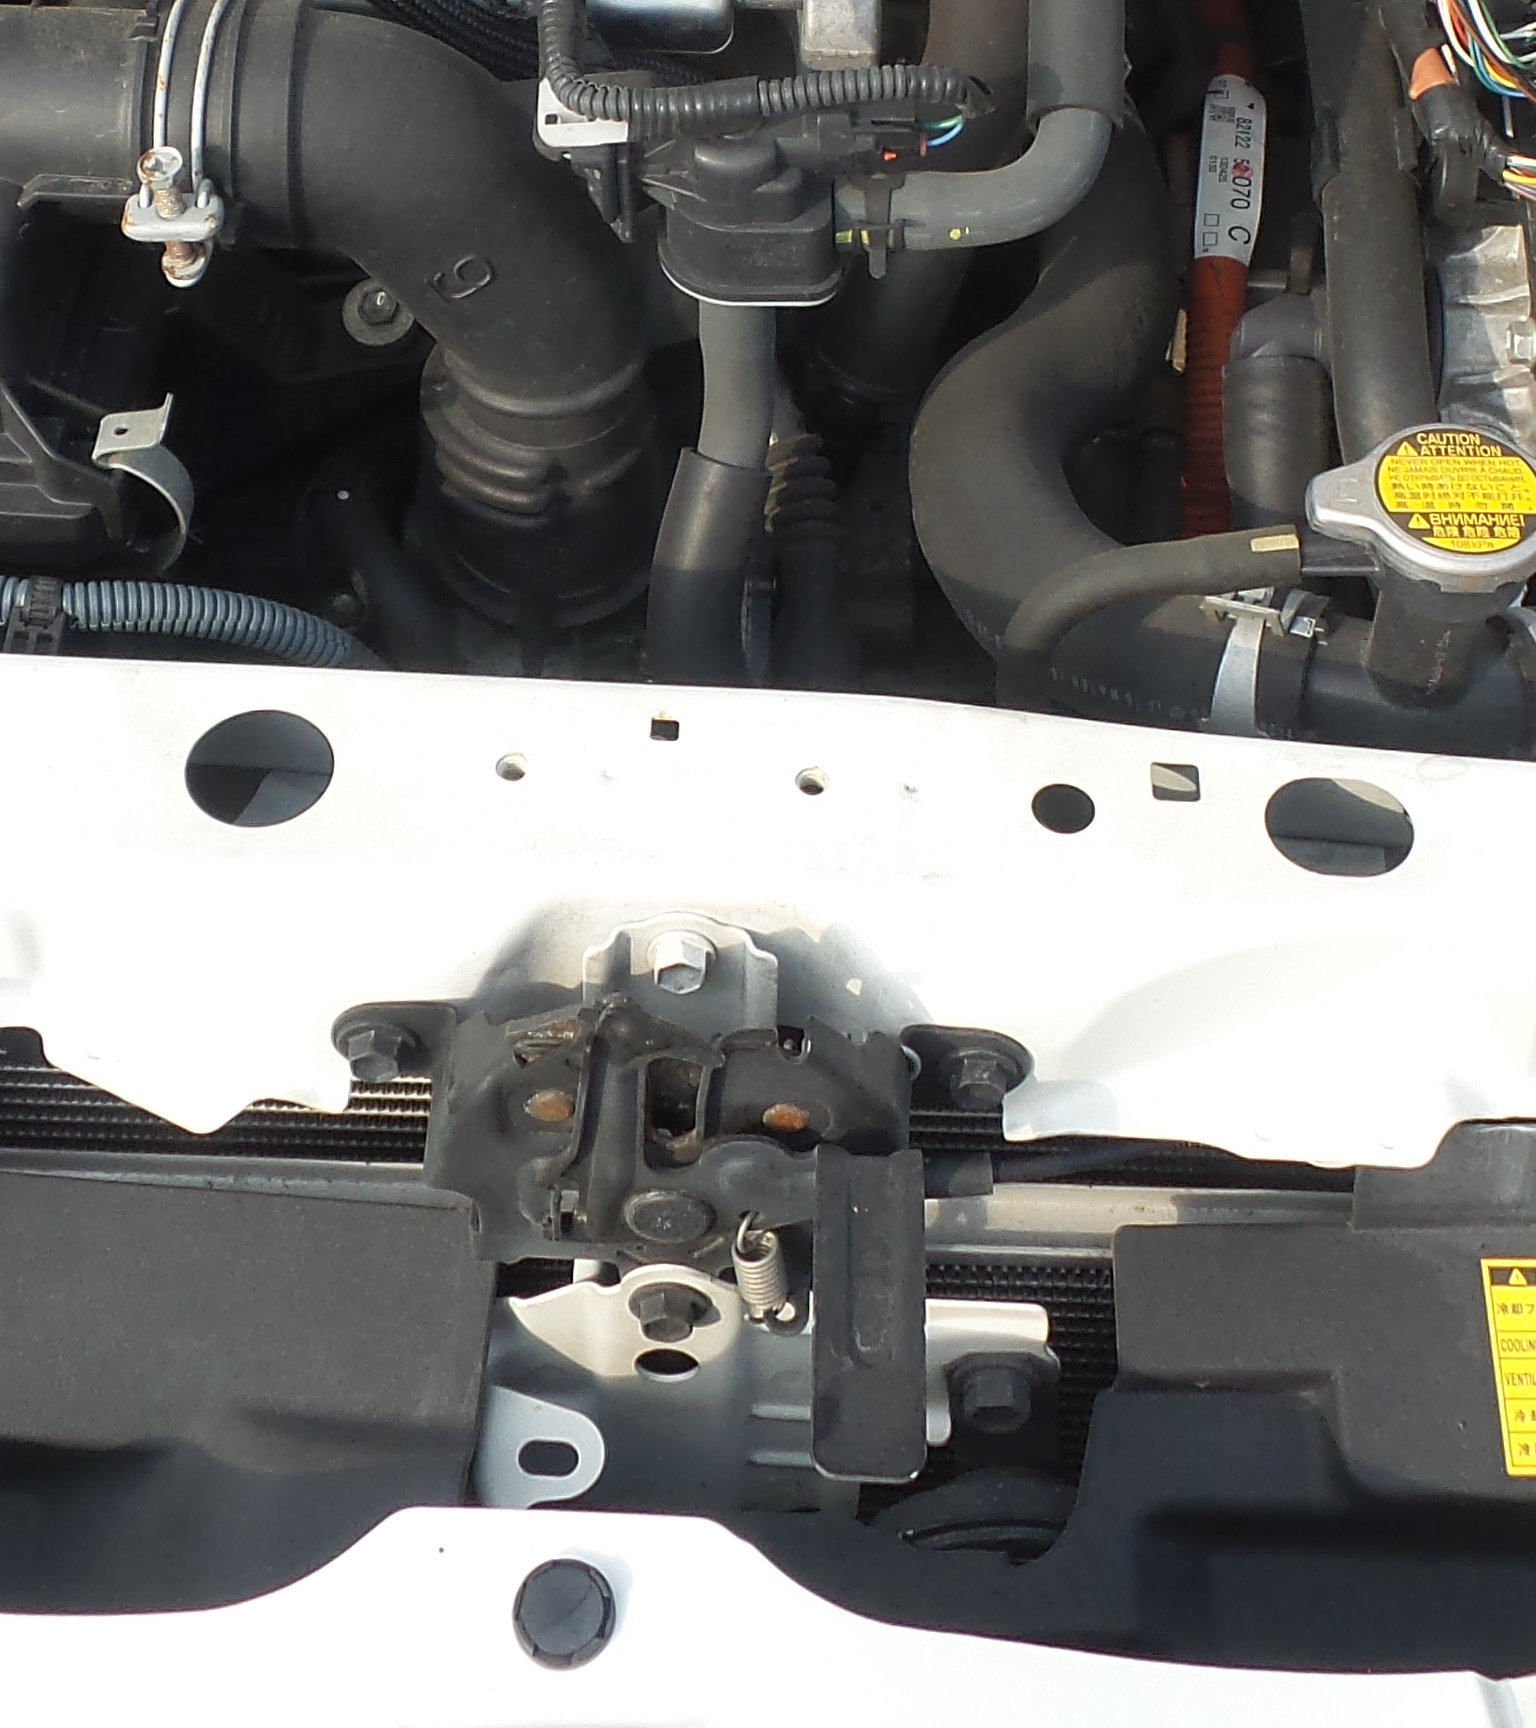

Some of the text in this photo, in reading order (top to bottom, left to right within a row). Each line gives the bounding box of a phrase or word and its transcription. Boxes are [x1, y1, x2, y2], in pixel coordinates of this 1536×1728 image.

[1233, 116, 1253, 149] 82122
[1227, 225, 1252, 246] C
[1416, 432, 1481, 445] CAUTION
[1420, 445, 1503, 457] ATTENTION
[1390, 458, 1428, 466] NEVER
[1430, 458, 1461, 466] OPEN
[1429, 513, 1526, 528] ВНИМАНИЕ!
